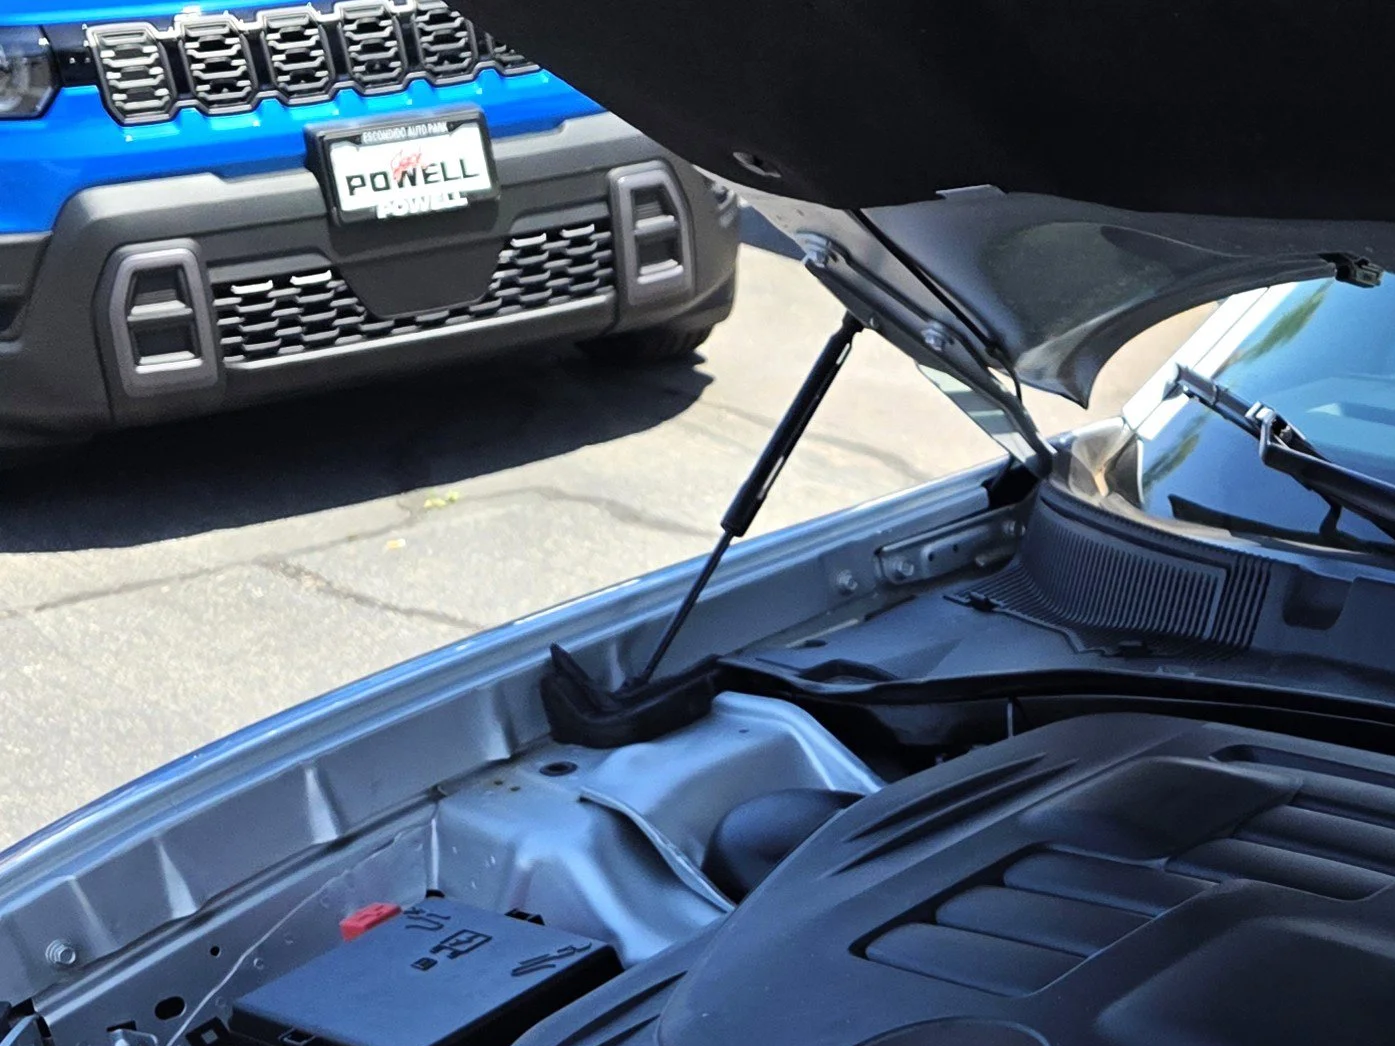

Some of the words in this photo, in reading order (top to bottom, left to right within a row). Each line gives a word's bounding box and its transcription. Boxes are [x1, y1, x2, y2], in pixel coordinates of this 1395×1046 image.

[362, 126, 407, 144] ESCONDIDO
[407, 123, 428, 138] AUTO
[427, 120, 448, 134] PARK
[345, 158, 480, 197] POWELL
